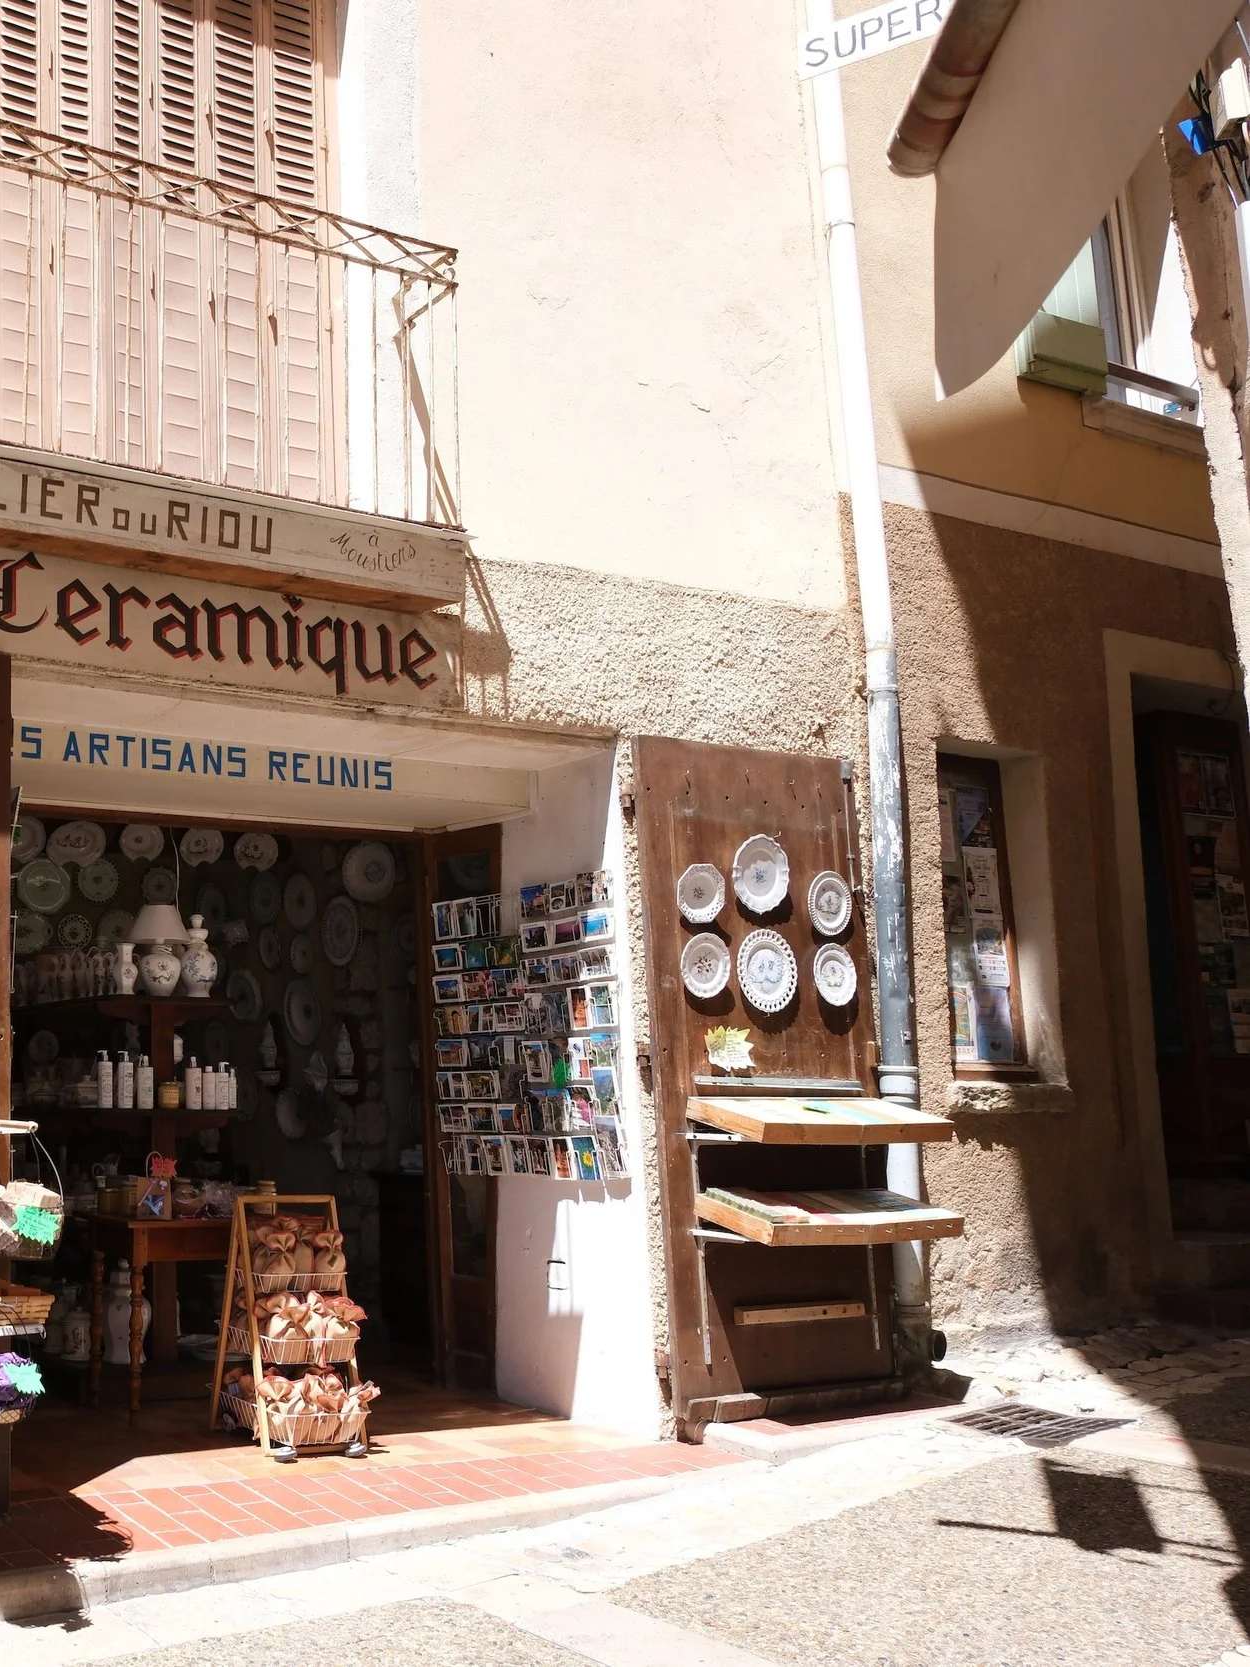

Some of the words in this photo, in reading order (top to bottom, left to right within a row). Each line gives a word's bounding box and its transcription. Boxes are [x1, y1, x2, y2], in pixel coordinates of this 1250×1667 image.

[167, 500, 273, 555] RIOU
[368, 530, 380, 548] à
[330, 533, 416, 572] Moustiers
[11, 727, 43, 759] S
[62, 731, 246, 777] ARTISANS
[268, 750, 392, 790] REUNIS
